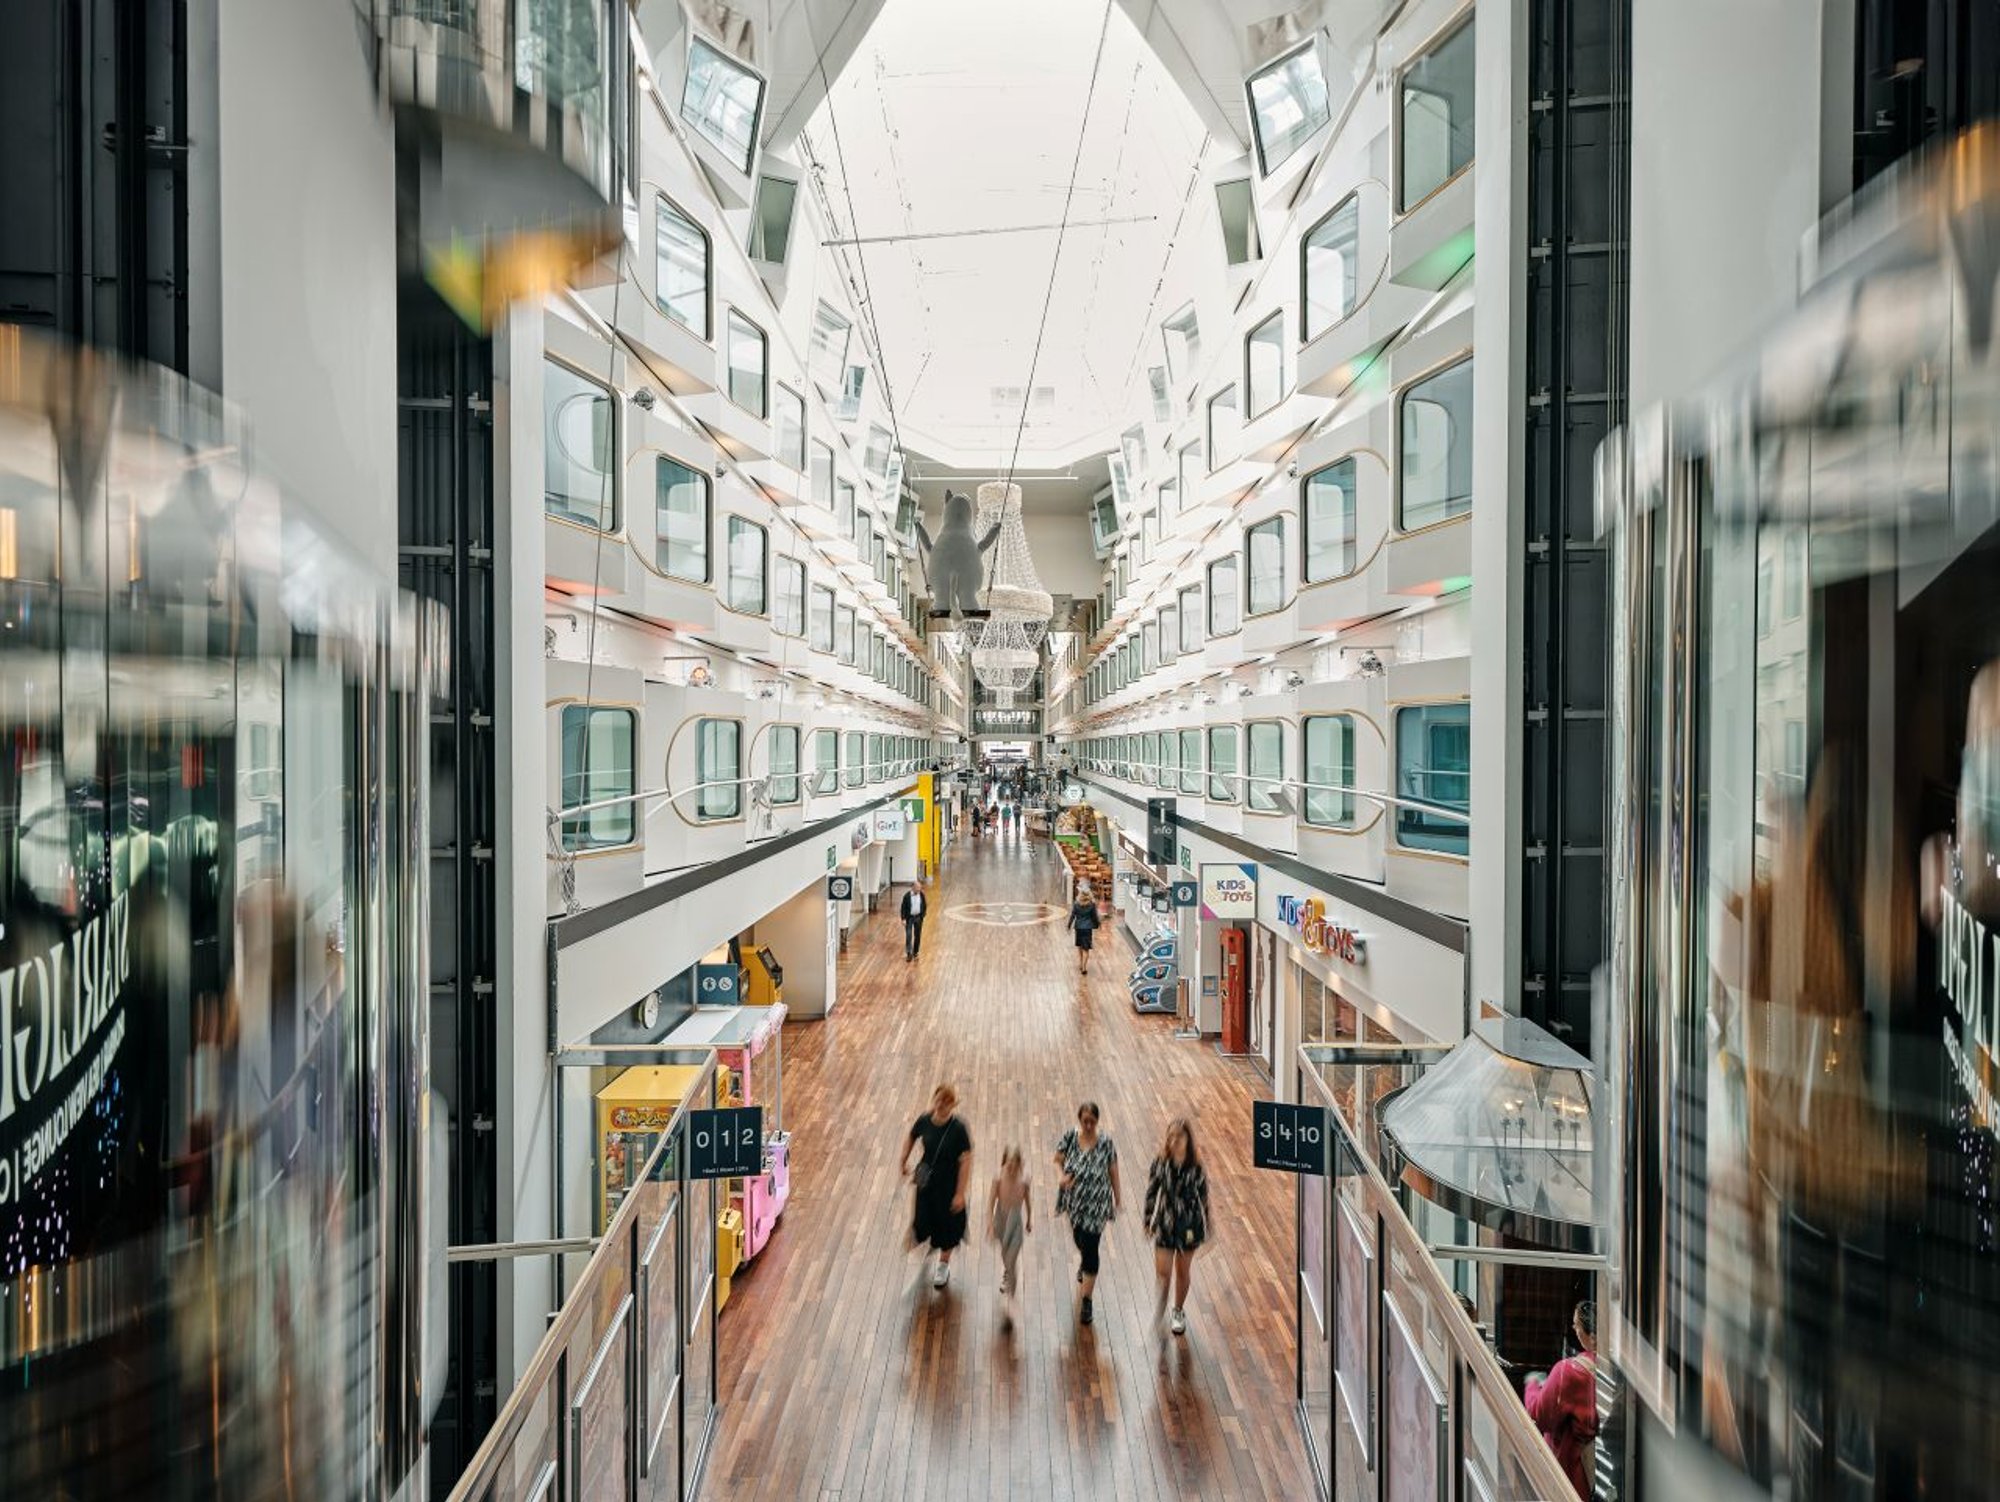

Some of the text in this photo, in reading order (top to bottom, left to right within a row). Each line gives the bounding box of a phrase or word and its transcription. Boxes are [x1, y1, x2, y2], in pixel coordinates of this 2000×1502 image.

[1152, 825, 1173, 834] info
[1216, 879, 1246, 890] KIDS
[1222, 891, 1253, 902] TOYS
[696, 1128, 754, 1148] 0 1 2
[1259, 1122, 1320, 1144] 3 4 10
